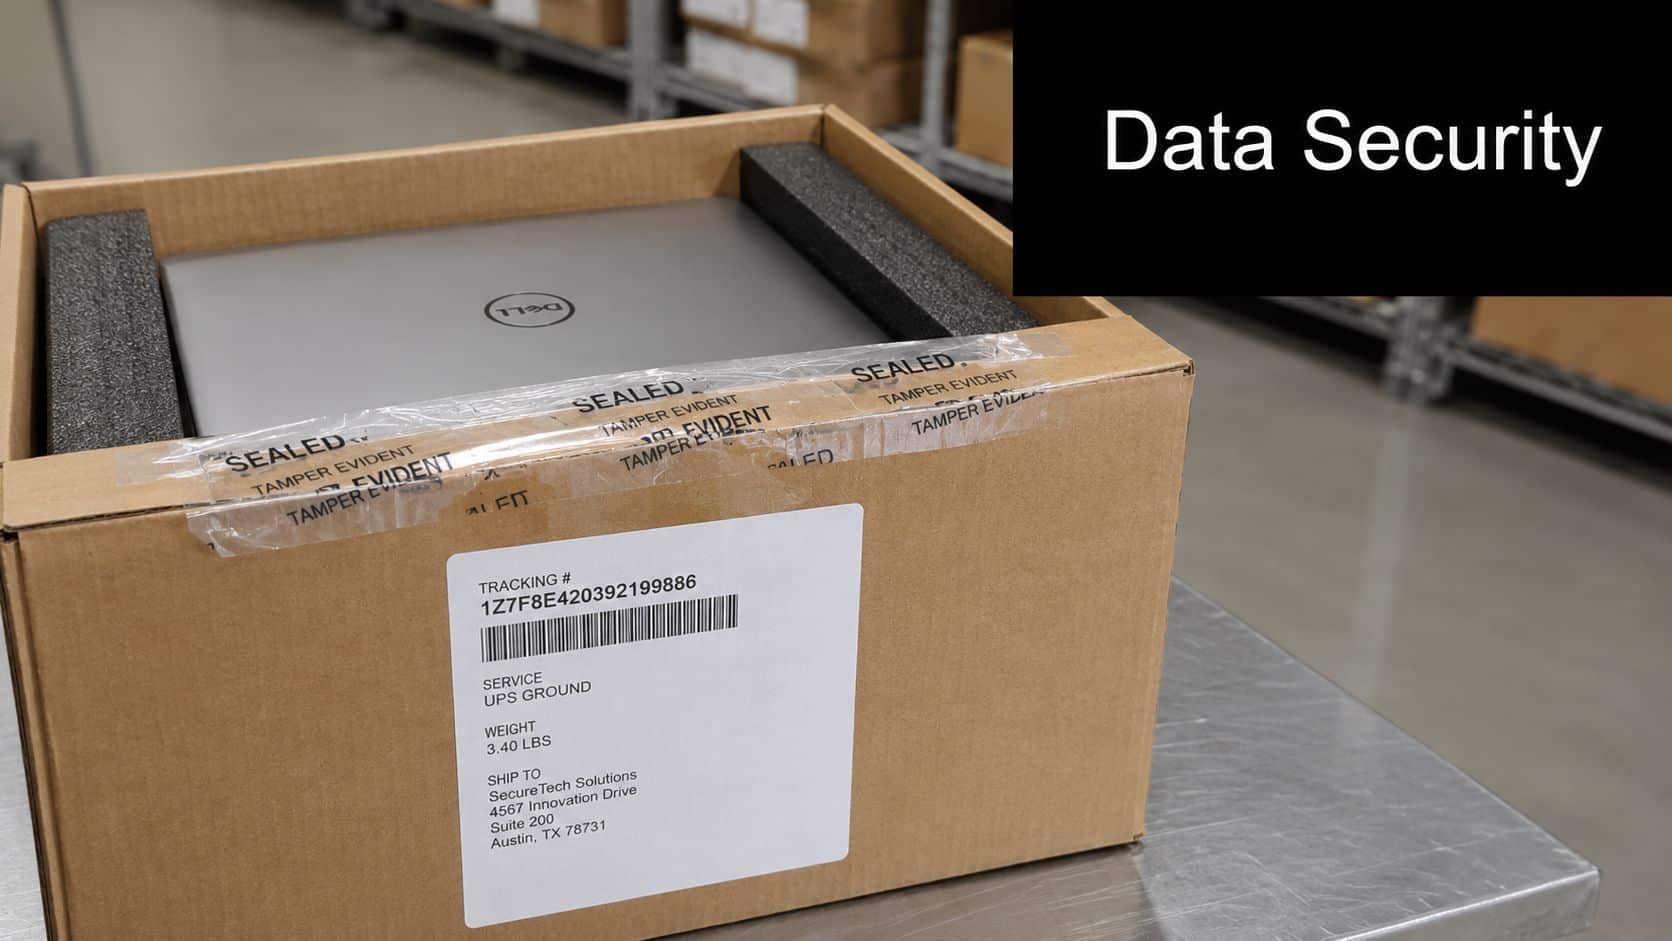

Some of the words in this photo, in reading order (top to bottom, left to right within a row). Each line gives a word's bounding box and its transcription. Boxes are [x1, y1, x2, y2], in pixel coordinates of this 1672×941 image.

[496, 303, 563, 317] DELL
[572, 380, 685, 414] SEALED
[879, 382, 947, 406] TAMPER
[949, 369, 1018, 393] EVIDENT
[599, 410, 669, 438] TAMPER
[672, 394, 739, 418] EVIDENT
[912, 403, 979, 435] TAMPER
[225, 434, 346, 472] SEALED
[619, 437, 692, 471] TAMPER
[251, 467, 332, 496] TAMPER
[334, 444, 415, 473] EVIDENT
[287, 488, 365, 526] TAMPER
[479, 573, 557, 595] TRACKING
[562, 572, 572, 585] #
[481, 574, 697, 616] 1Z7F8E420392199886
[482, 672, 543, 690] SERVICE
[484, 691, 517, 707] UPS
[522, 680, 592, 703] GROUND
[485, 721, 537, 738] WEIGHT
[487, 739, 518, 755] 3.40
[522, 735, 552, 750] LBS
[488, 771, 519, 786] SHIP
[523, 768, 541, 780] TO
[489, 780, 571, 802] SecureTech
[575, 770, 637, 789] Solutions
[489, 802, 524, 818] 4567
[528, 791, 598, 811] Innovation
[603, 785, 637, 800] Drive
[490, 818, 525, 834] Suite
[529, 813, 554, 827] 200
[491, 832, 537, 849] Austin,
[542, 828, 561, 841] TX
[565, 820, 606, 837] 78731
